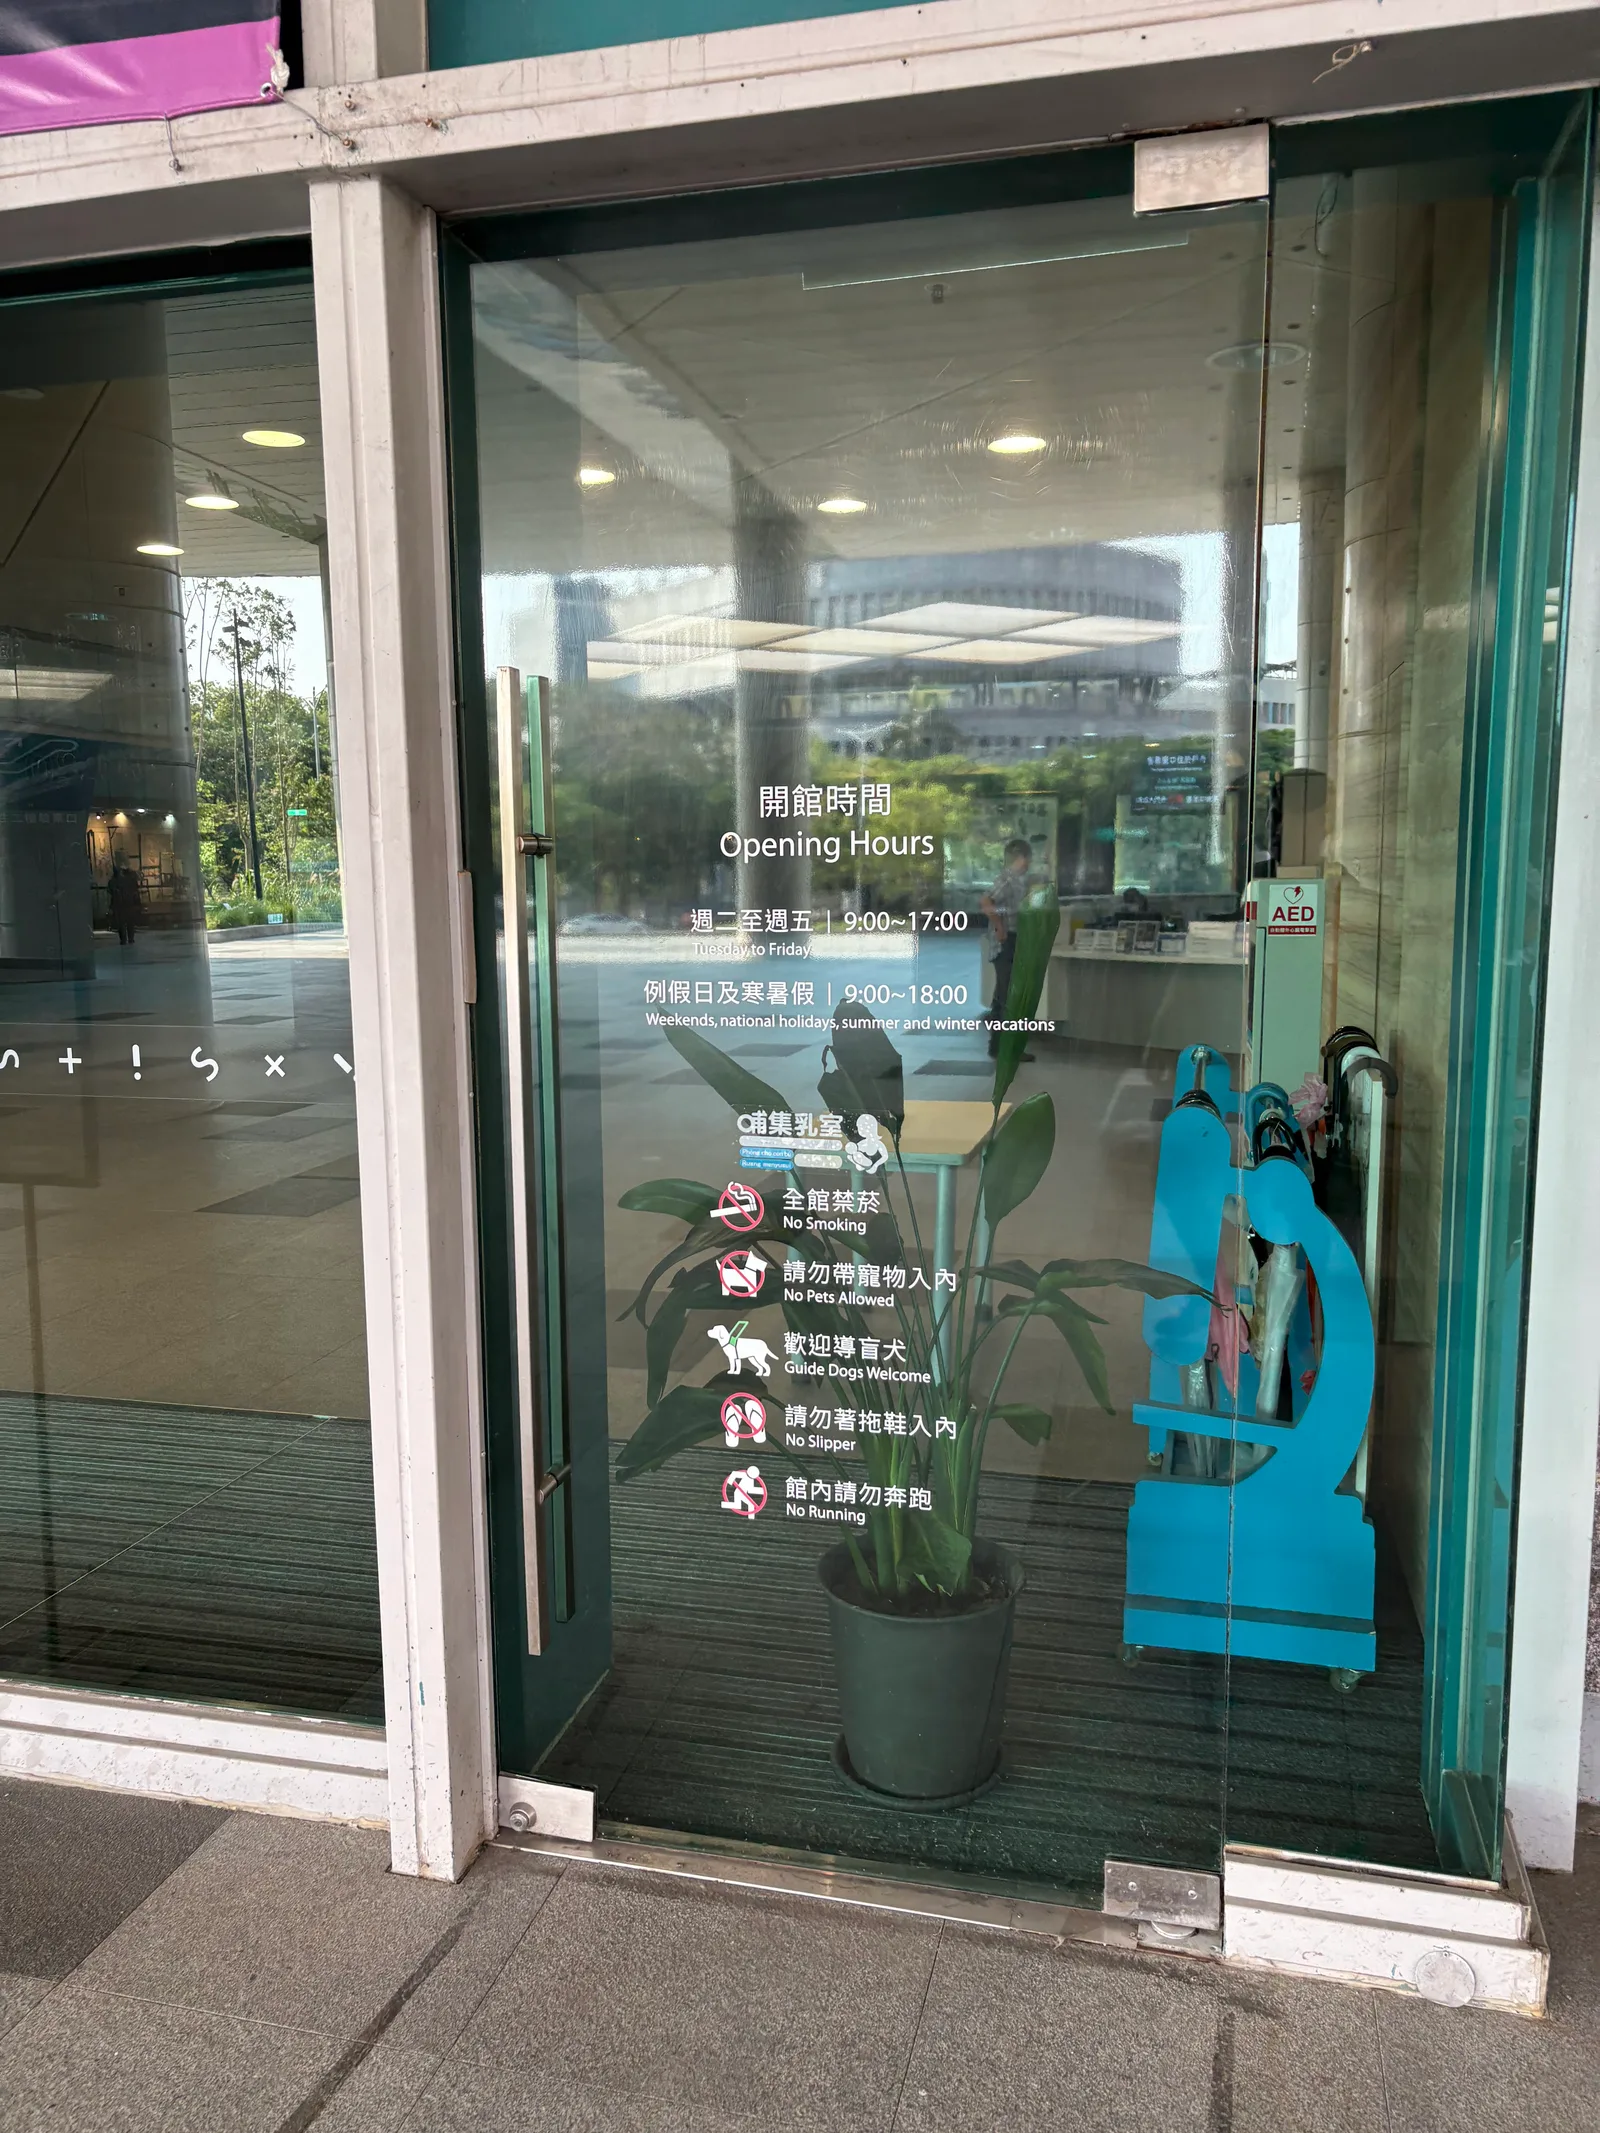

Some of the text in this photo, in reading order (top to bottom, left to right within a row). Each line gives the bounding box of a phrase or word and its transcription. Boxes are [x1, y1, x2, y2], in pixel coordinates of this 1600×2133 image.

[759, 783, 891, 818] 開館時間
[720, 830, 934, 863] Opening Hours
[690, 908, 814, 933] 週二至週五
[844, 911, 968, 932] 9:00~17:00
[1272, 906, 1315, 922] AED
[692, 942, 811, 959] Tuesday to Friday
[643, 979, 815, 1006] 例假日及寒暑假
[844, 984, 968, 1005] 9:00~18:00
[646, 1012, 1056, 1032] Weekends, national holidays, summer and winter vacations
[737, 1110, 844, 1137] 哺集乳室
[782, 1187, 881, 1214] 全館禁菸
[783, 1216, 867, 1235] No Smoking
[782, 1260, 957, 1292] 請勿帶寵物入內
[784, 1288, 895, 1307] No Pets Allowed
[783, 1331, 907, 1362] 歡迎導盲犬
[784, 1361, 932, 1384] Guide Dogs Welcome
[784, 1404, 957, 1440] 請勿著拖鞋入內
[785, 1432, 857, 1452] No Slipper
[785, 1475, 933, 1511] 館內請勿奔跑
[786, 1503, 866, 1525] No Running
